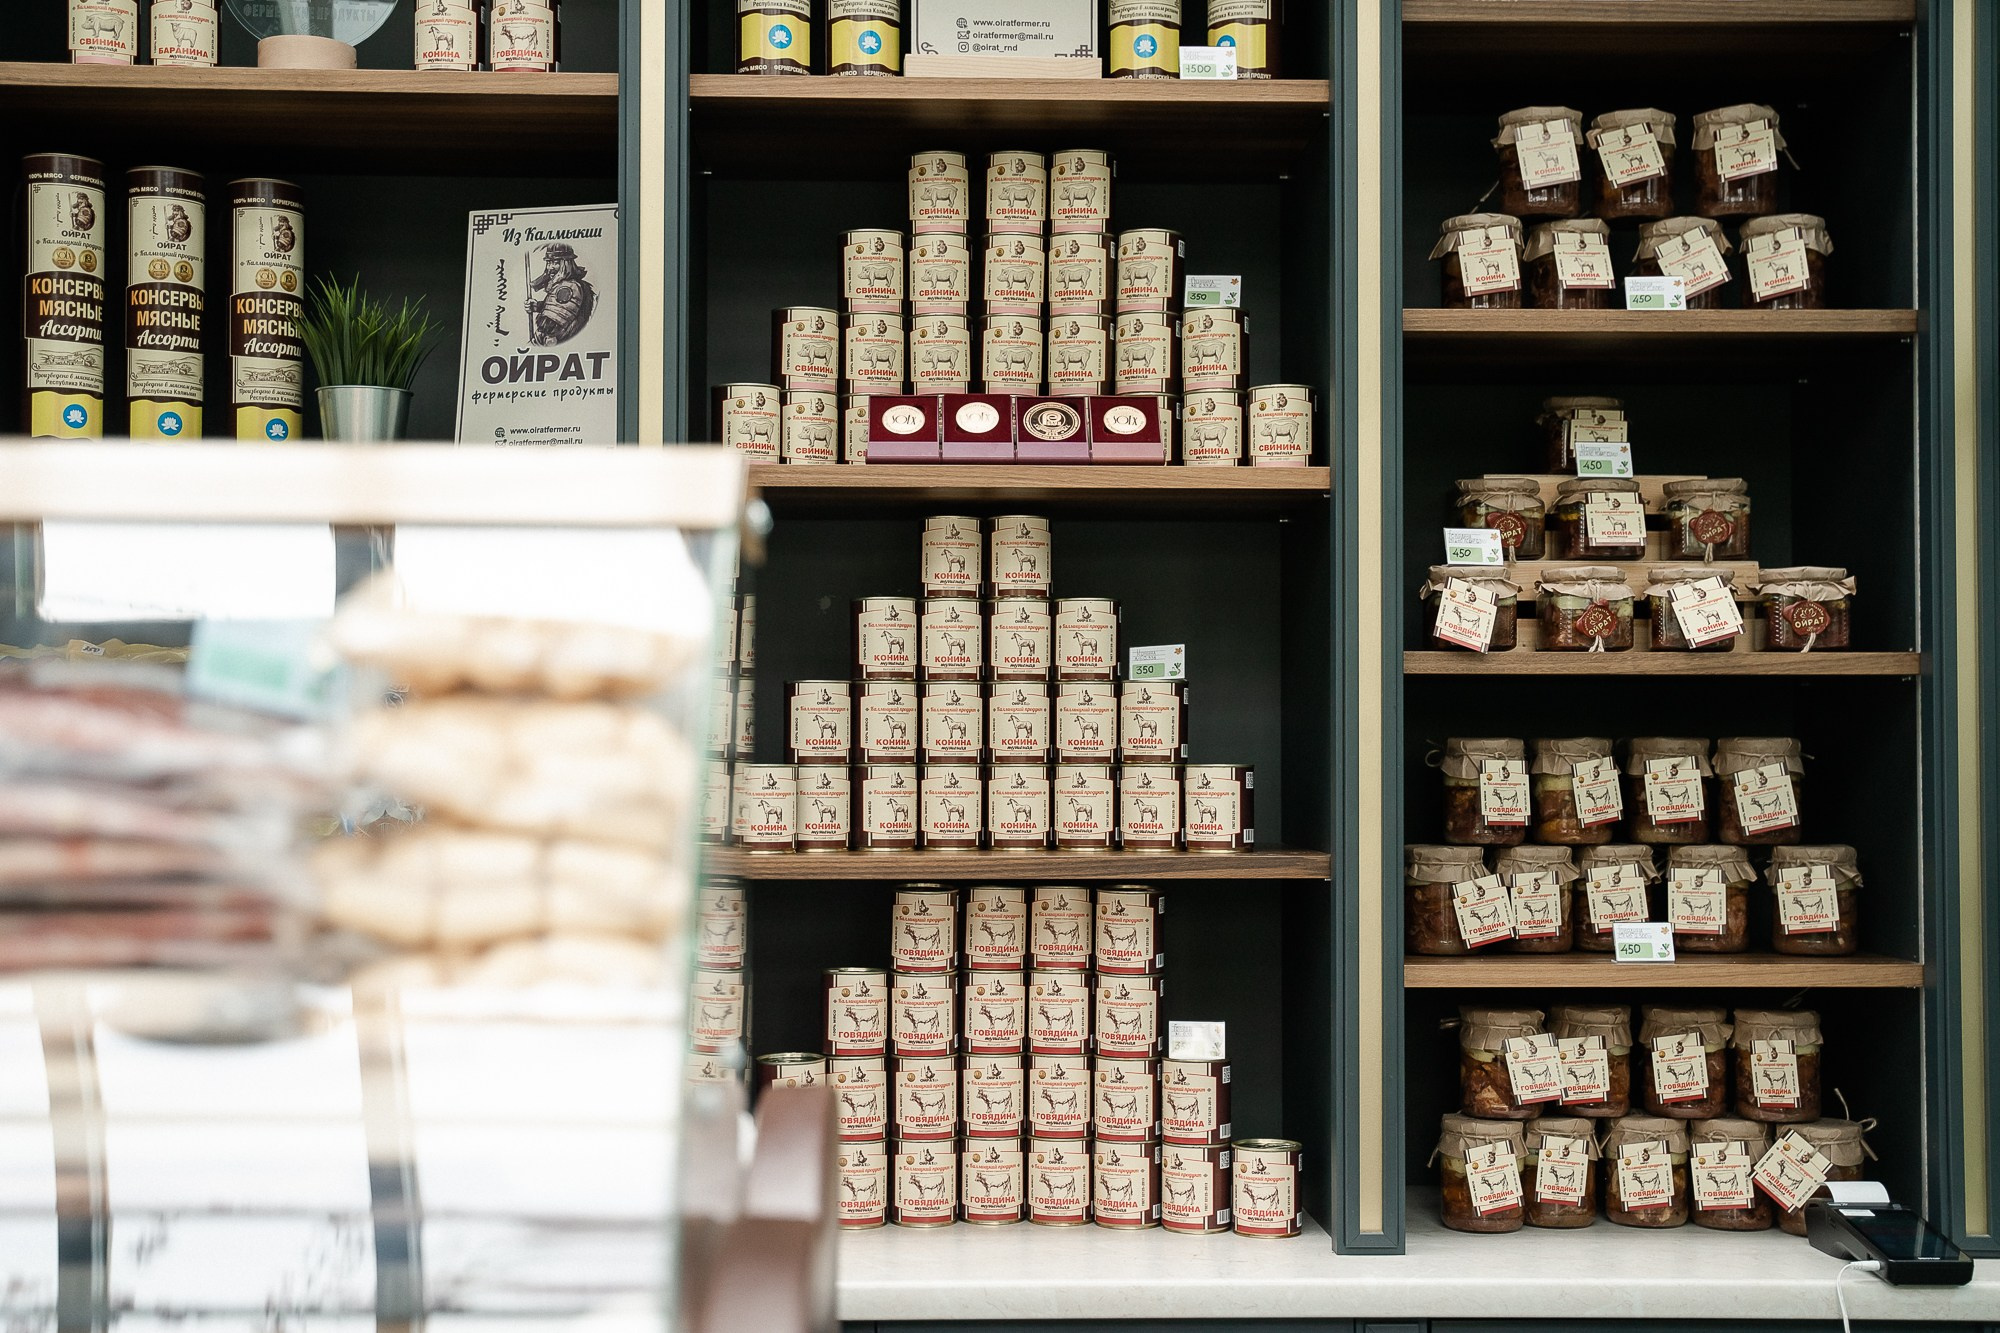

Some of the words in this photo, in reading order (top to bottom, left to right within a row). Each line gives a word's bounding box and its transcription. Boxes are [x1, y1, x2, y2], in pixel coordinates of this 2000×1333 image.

[972, 19, 1051, 28] www.oiratfermer.ru
[972, 31, 1055, 42] oiratfermer@mail.ru
[80, 38, 126, 49] СВИНИНА
[972, 43, 1018, 53] @oirat_rnd
[158, 47, 208, 58] БАРАНИНА
[423, 51, 461, 59] КОНИНА
[496, 49, 543, 59] ГОВЯДИНА
[1730, 157, 1763, 171] КОНИНА
[1535, 165, 1566, 175] КОНИНА
[1619, 163, 1651, 177] КОНИНА
[996, 208, 1037, 216] СВИНИНА
[1057, 207, 1098, 215] СВИНИНА
[61, 229, 92, 240] ОЙРАТ
[502, 228, 521, 246] Из
[524, 226, 603, 243] Калмыкии
[157, 240, 187, 251] ОЙРАТ
[263, 250, 291, 262] ОЙРАТ
[1475, 273, 1505, 283] КОНИНА
[1764, 275, 1795, 287] КОНИНА
[855, 287, 897, 295] СВИНИНА
[994, 289, 1035, 298] СВИНИНА
[1055, 289, 1093, 297] СВИНИНА
[131, 289, 204, 311] КОНСЕРВЫ
[1190, 292, 1207, 300] 350
[1632, 294, 1652, 304] 450
[39, 299, 103, 322] МЯСНЫЕ
[137, 311, 201, 331] МЯСНЫЕ
[39, 319, 102, 341] Ассорти
[137, 329, 200, 350] Ассорти
[243, 337, 302, 358] Ассорти
[481, 347, 610, 385] ОЙРАТ
[795, 365, 833, 374] СВИНИНА
[1188, 363, 1228, 373] СВИНИНА
[858, 369, 897, 377] СВИНИНА
[920, 370, 961, 378] СВИНИНА
[993, 370, 1034, 379] СВИНИНА
[1119, 367, 1157, 376] СВИНИНА
[471, 387, 547, 405] фермерские
[553, 386, 614, 402] продукты
[510, 425, 581, 434] www.oiratfermer.ru
[737, 442, 775, 451] СВИНИНА
[795, 447, 833, 456] СВИНИНА
[1582, 460, 1603, 470] 450
[1700, 523, 1727, 541] ОЙРАТ
[1452, 548, 1472, 558] 450
[934, 572, 971, 580] КОНИНА
[1588, 614, 1613, 637] ОЙРАТ
[1697, 620, 1728, 633] КОНИНА
[1794, 616, 1825, 629] ОЙРАТ
[1443, 620, 1482, 640] ГОВЯДИНА
[934, 655, 971, 663] КОНИНА
[1066, 655, 1103, 663] КОНИНА
[1136, 665, 1154, 675] 350
[805, 738, 842, 746] КОНИНА
[1001, 738, 1039, 746] КОНИНА
[1067, 739, 1104, 747] КОНИНА
[1127, 737, 1163, 745] КОНИНА
[1584, 804, 1614, 814] ГОВЯДИНА
[1657, 803, 1694, 811] ГОВЯДИНА
[1750, 809, 1787, 821] ГОВЯДИНА
[751, 824, 788, 832] КОНИНА
[805, 822, 841, 830] КОНИНА
[933, 821, 970, 829] КОНИНА
[1000, 822, 1037, 830] КОНИНА
[1062, 821, 1098, 829] КОНИНА
[1128, 822, 1163, 830] КОНИНА
[1189, 823, 1223, 831] КОНИНА
[1600, 911, 1638, 920] ГОВЯДИНА
[1469, 921, 1506, 934] ГОВЯДИНА
[975, 945, 1020, 954] ГОВЯДИНА
[1038, 944, 1084, 952] ГОВЯДИНА
[1620, 943, 1641, 955] 450
[899, 949, 945, 957] ГОВЯДИНА
[1101, 948, 1145, 958] ГОВЯДИНА
[838, 1031, 883, 1040] ГОВЯДИНА
[899, 1032, 944, 1041] ГОВЯДИНА
[973, 1029, 1019, 1038] ГОВЯДИНА
[1034, 1029, 1079, 1039] ГОВЯДИНА
[1101, 1032, 1146, 1042] ГОВЯДИНА
[1520, 1081, 1557, 1091] ГОВЯДИНА
[1567, 1083, 1601, 1092] ОВЯДИНА
[1664, 1081, 1700, 1089] ГОВЯДИНА
[838, 1116, 881, 1125] ОВЯДИНА
[905, 1115, 950, 1124] ГОВЯДИНА
[971, 1113, 1017, 1121] ГОВЯДИНА
[1037, 1113, 1081, 1122] ГОВЯДИНА
[1099, 1116, 1143, 1128] ГОВЯДИНА
[1762, 1167, 1797, 1200] ГОВЯДИНА
[1544, 1185, 1577, 1193] ГОВЯДИНА
[970, 1196, 1016, 1205] ГОВЯДИНА
[1480, 1190, 1514, 1202] ГОВЯДИНА
[838, 1200, 881, 1209] ОВЯДИНА
[903, 1199, 949, 1207] ГОВЯДИНА
[1036, 1197, 1080, 1206] ГОВЯДИНА
[1097, 1199, 1138, 1209] ГОВЯДИНА
[1239, 1208, 1284, 1218] ГОВЯДИНА
